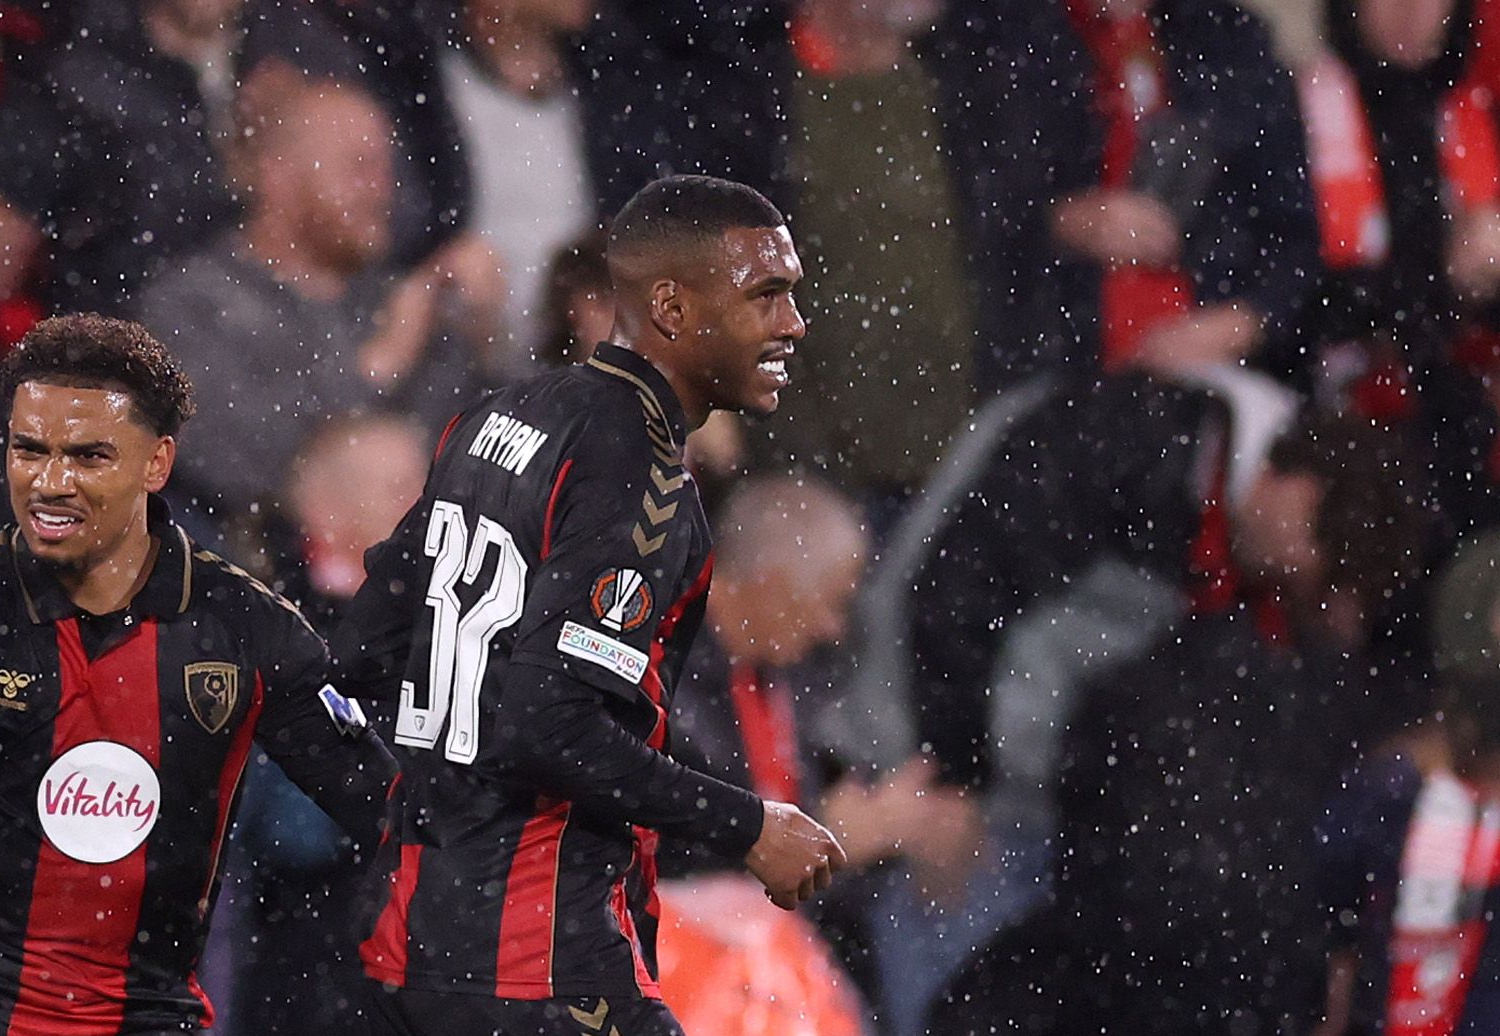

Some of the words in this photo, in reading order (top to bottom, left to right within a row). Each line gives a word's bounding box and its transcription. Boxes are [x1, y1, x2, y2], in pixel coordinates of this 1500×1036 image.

[468, 411, 549, 476] RAYAN
[562, 630, 644, 674] FOUNDATION
[46, 771, 155, 832] Vitality
